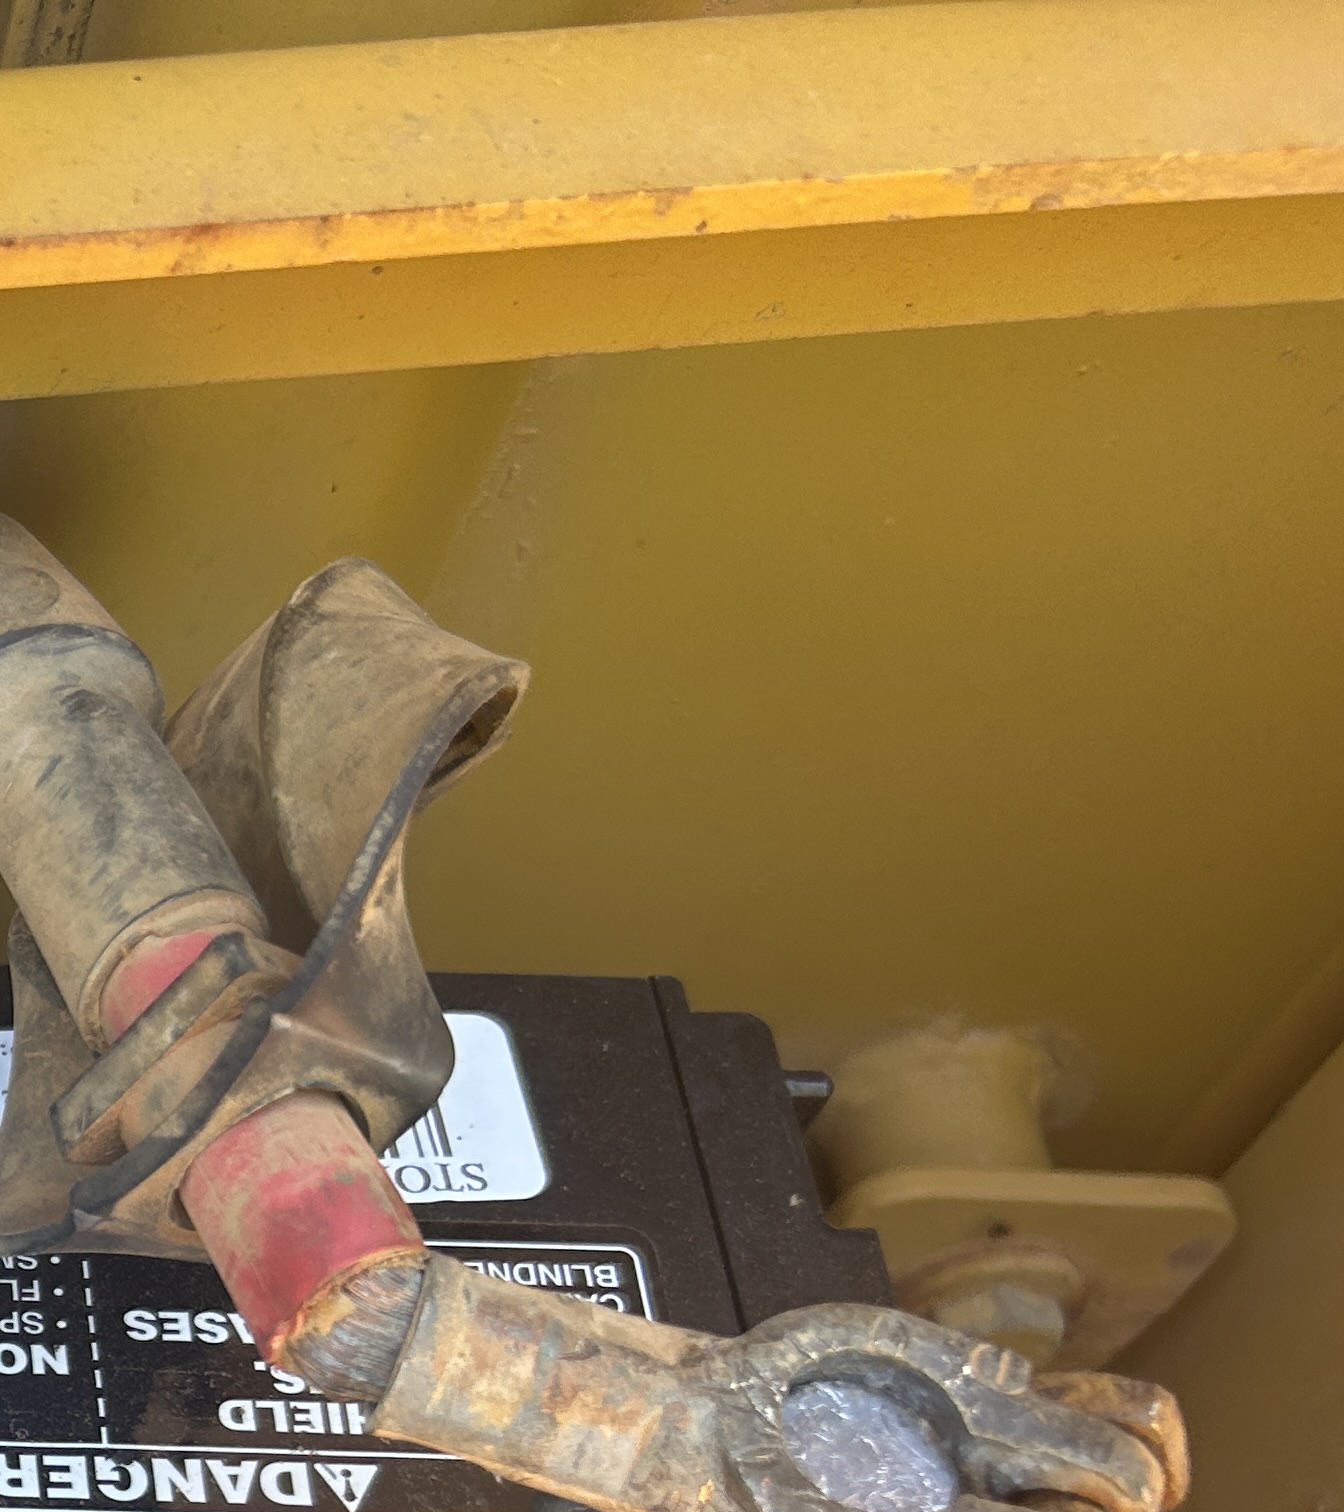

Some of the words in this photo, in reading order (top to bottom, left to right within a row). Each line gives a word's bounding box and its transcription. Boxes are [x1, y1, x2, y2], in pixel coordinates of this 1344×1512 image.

[386, 1162, 488, 1194] STO
[466, 1261, 620, 1287] BLINDN
[123, 1310, 248, 1343] ASES
[218, 1400, 372, 1434] HIELD
